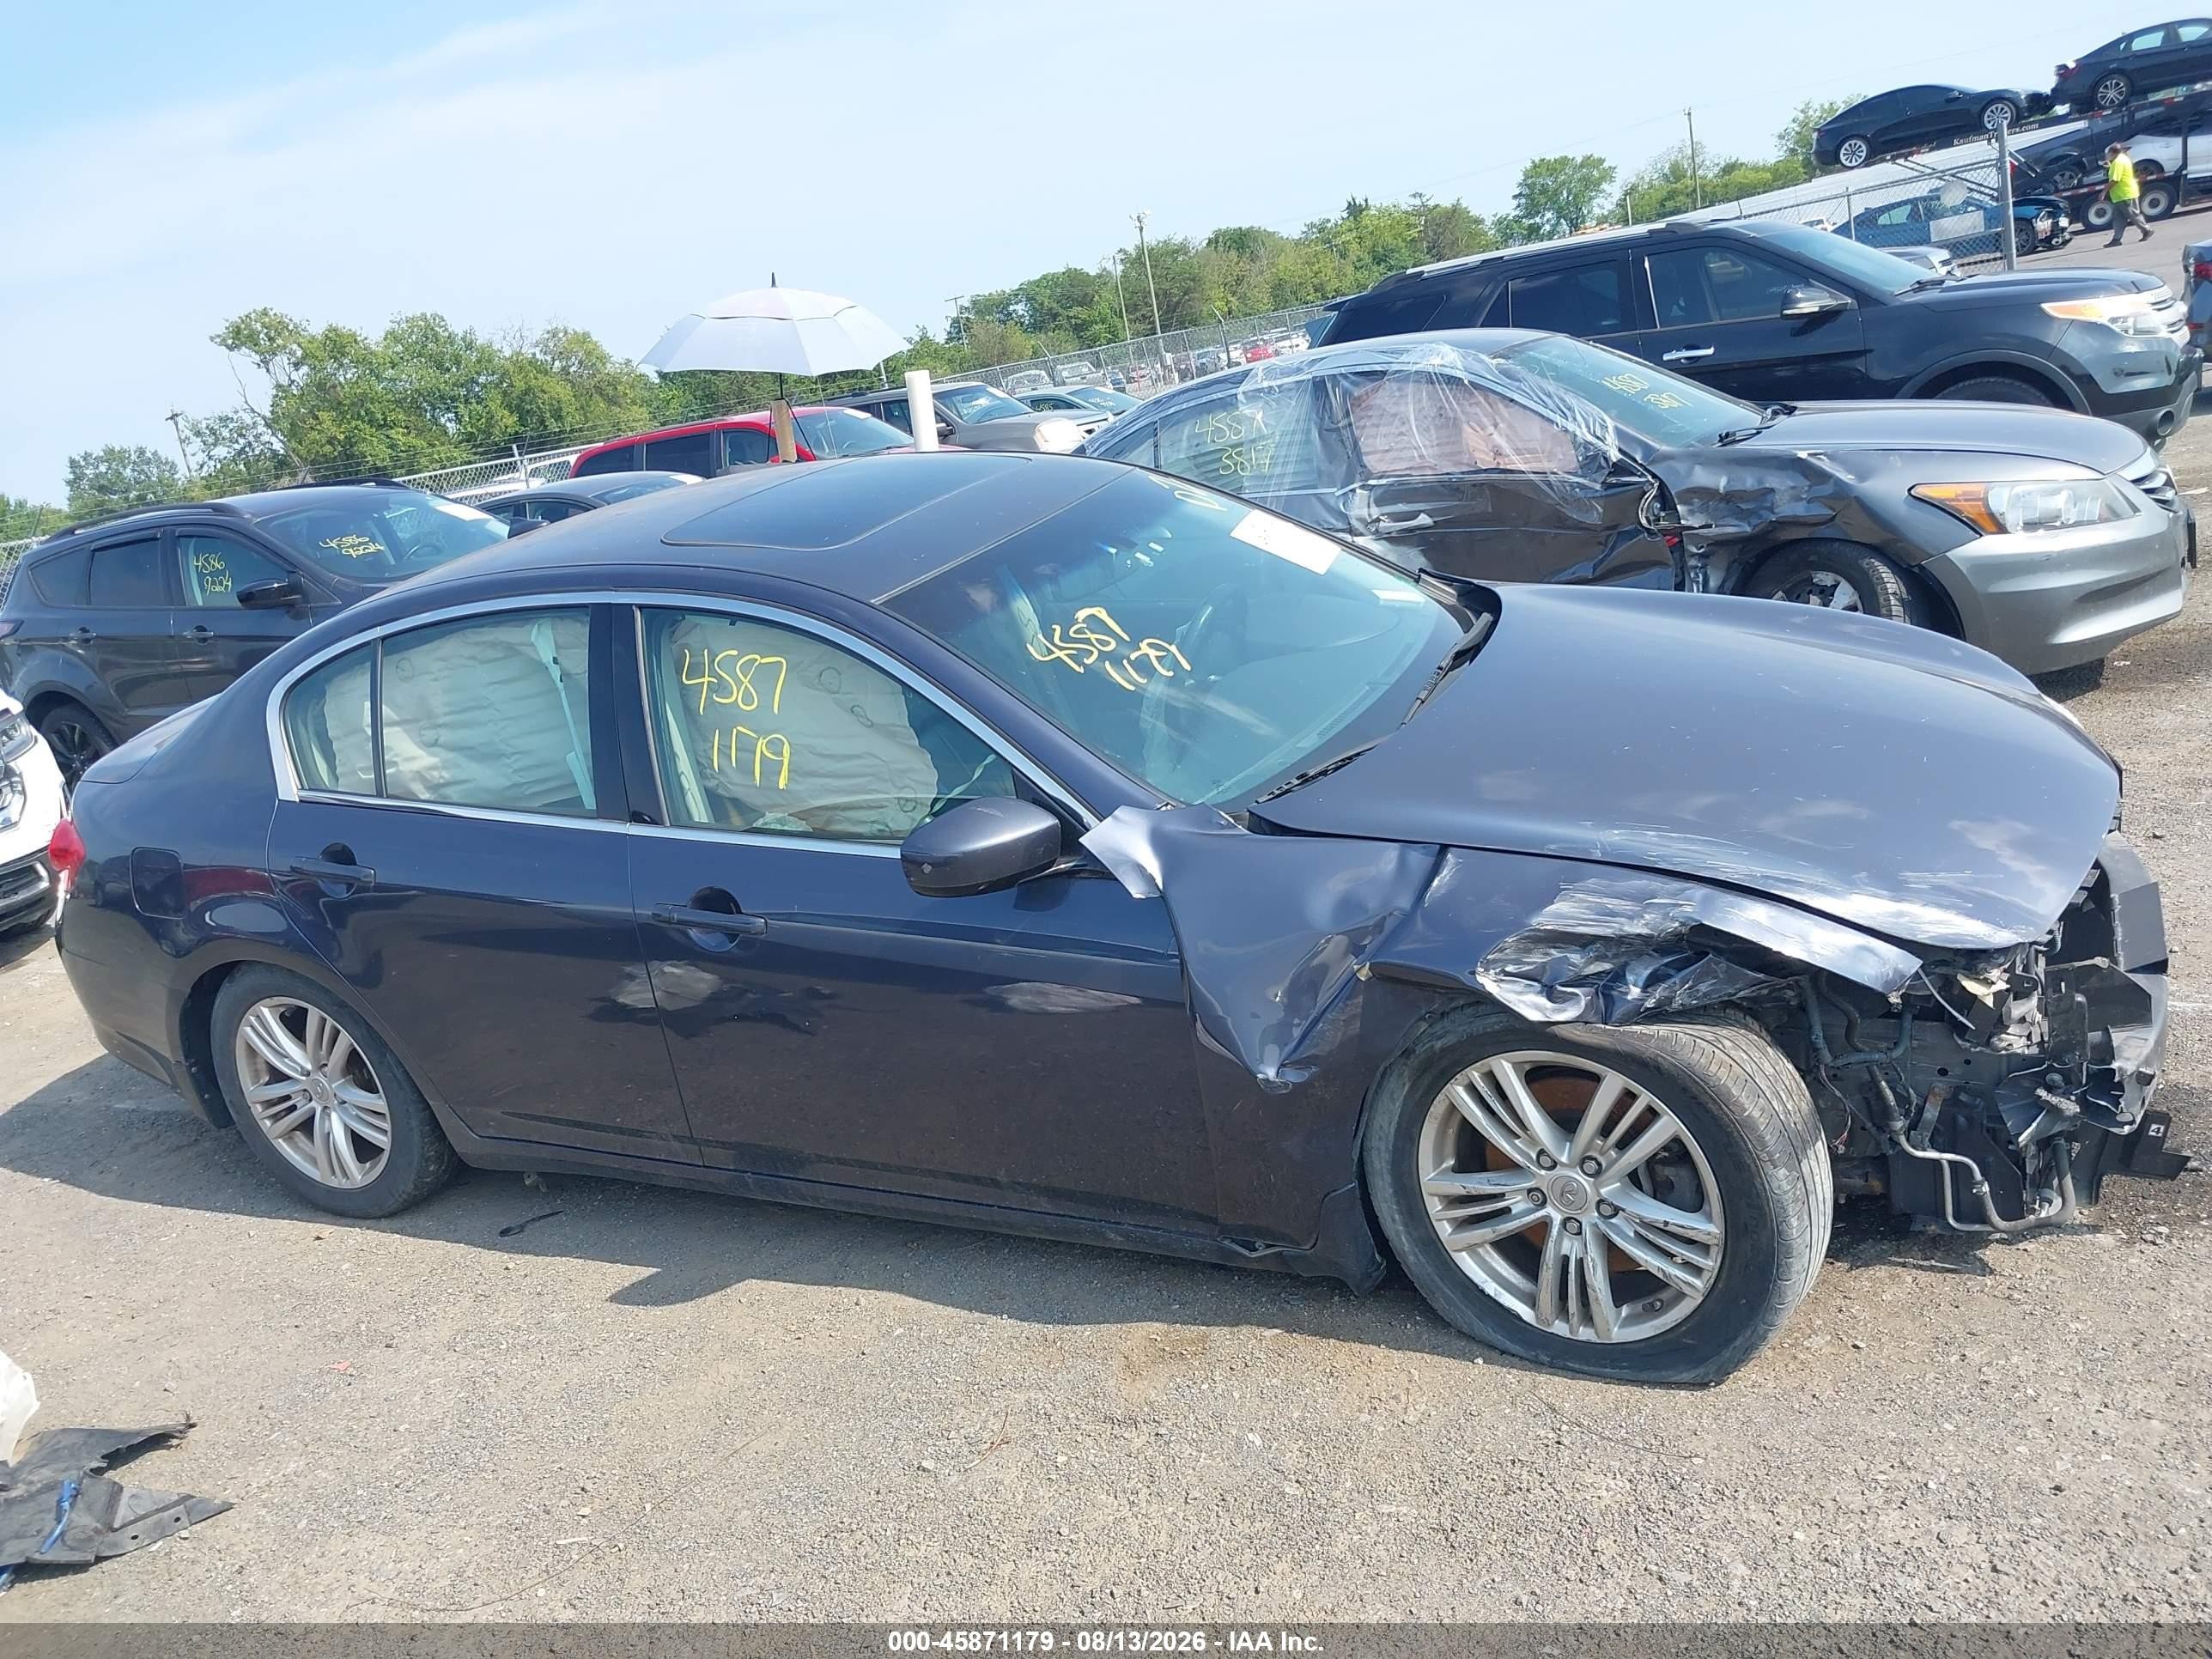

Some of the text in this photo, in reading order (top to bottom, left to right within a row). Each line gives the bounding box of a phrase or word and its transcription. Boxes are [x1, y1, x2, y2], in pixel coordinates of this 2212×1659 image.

[1952, 122, 2039, 147] KaufmanTrers.com
[1601, 373, 1649, 395] 4587
[1219, 444, 1273, 476] 3817
[319, 534, 370, 550] 4586
[193, 551, 226, 573] 4586
[204, 569, 232, 597] 9224
[1026, 606, 1132, 674] 4587
[1104, 638, 1192, 691] 1179
[682, 647, 787, 715] 4587
[712, 725, 792, 791] 1179
[2150, 1127, 2163, 1135] 4
